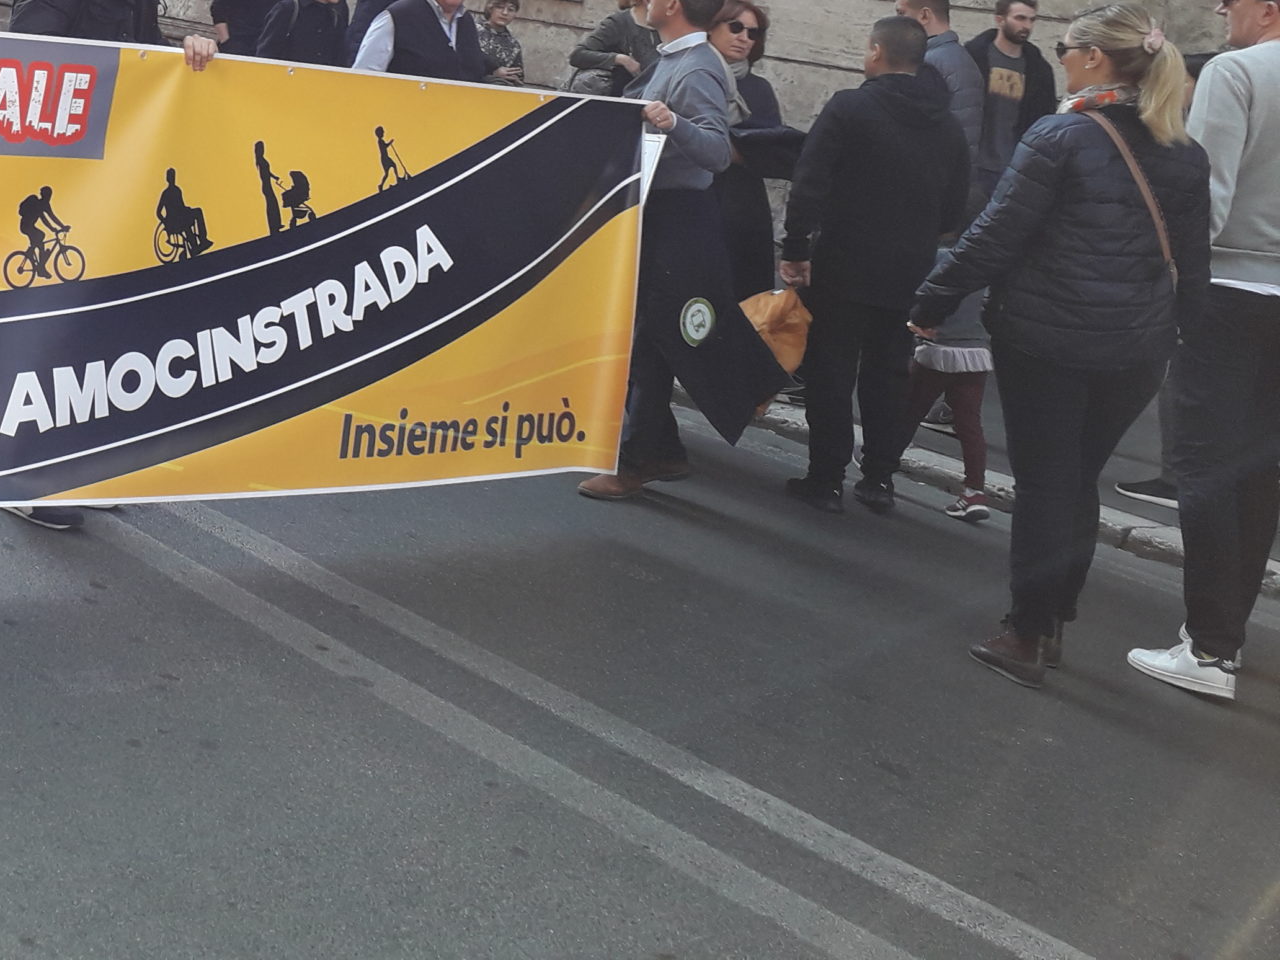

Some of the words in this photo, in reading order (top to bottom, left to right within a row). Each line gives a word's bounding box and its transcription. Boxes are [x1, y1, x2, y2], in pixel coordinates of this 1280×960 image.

[338, 407, 479, 459] Insieme
[482, 401, 510, 449] si
[514, 397, 586, 459] può.
